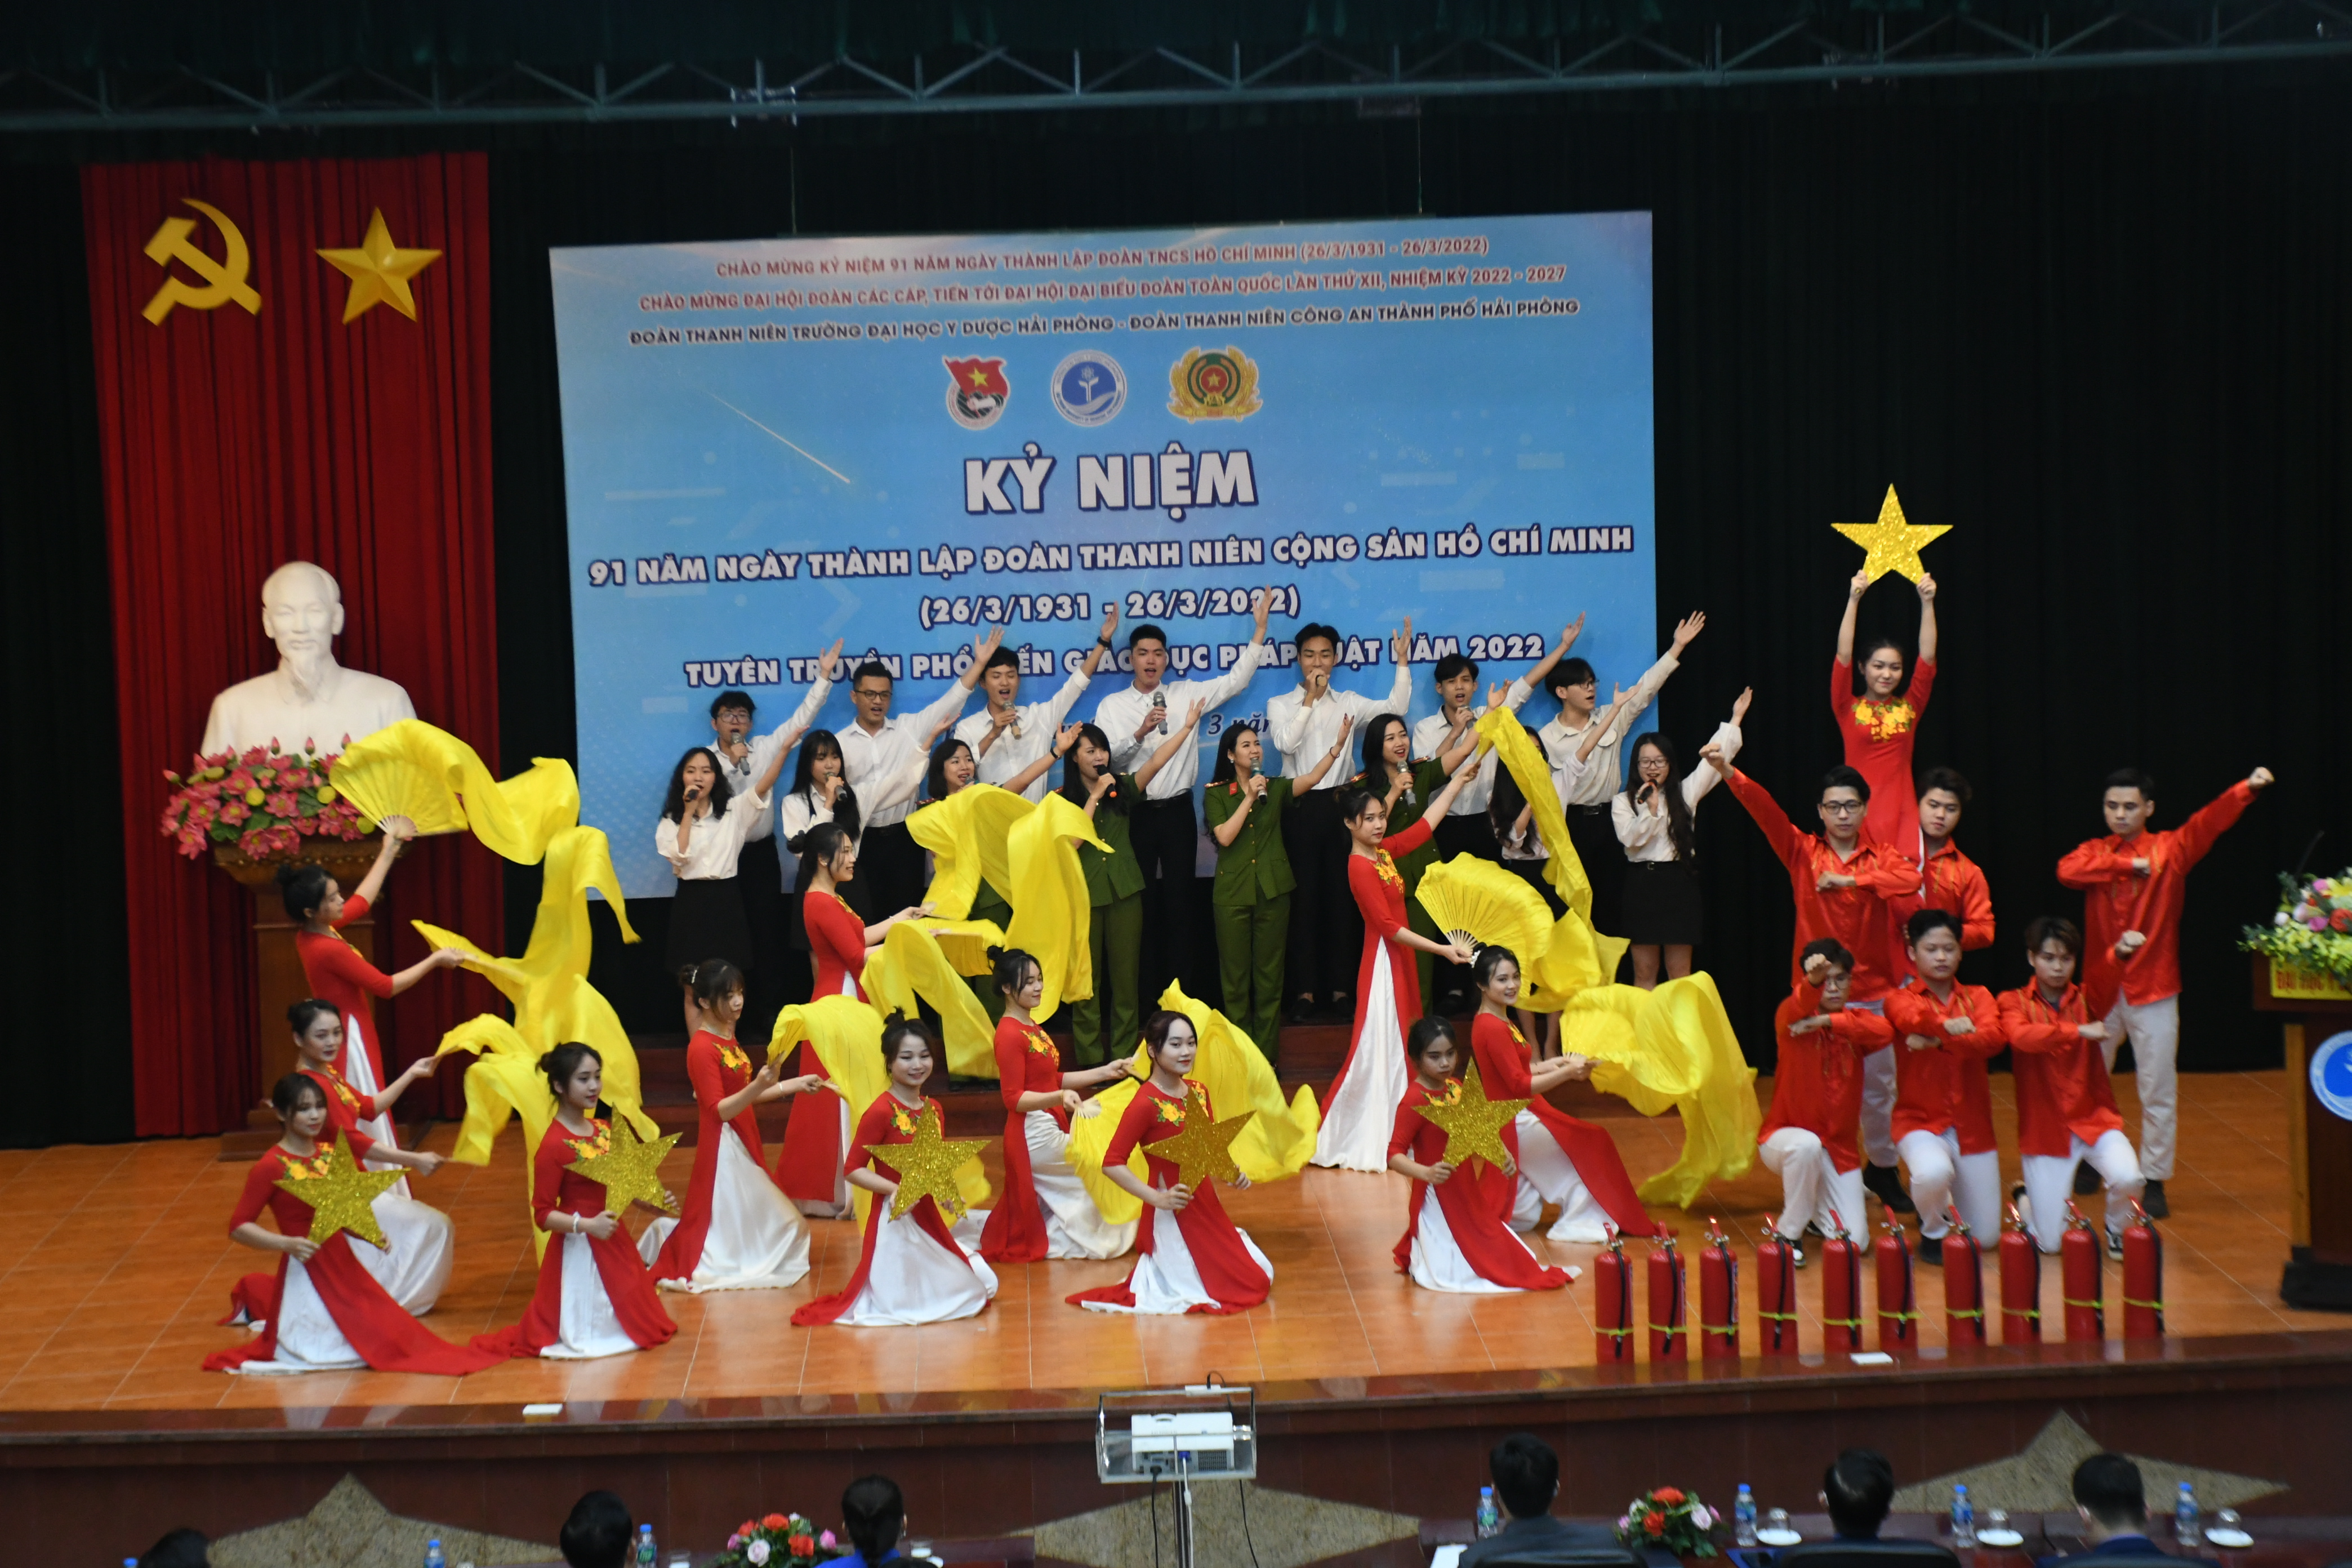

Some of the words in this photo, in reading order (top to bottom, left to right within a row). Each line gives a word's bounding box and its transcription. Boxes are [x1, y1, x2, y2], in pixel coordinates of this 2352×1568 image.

[890, 259, 907, 271] 91
[956, 252, 997, 270] NGÀY
[1003, 252, 1058, 269] THÀNH
[1062, 249, 1093, 271] LẬP
[1147, 249, 1190, 266] TNCS
[1222, 243, 1250, 262] CHÍ
[1254, 244, 1296, 261] MINH
[1301, 242, 1385, 262] (26/3/1931
[1402, 237, 1489, 256] 26/3/2022)
[639, 292, 685, 311] CHÀO
[743, 293, 771, 310] ĐẠI
[776, 288, 803, 310] HỘI
[808, 287, 853, 307] ĐOÀN
[857, 286, 889, 305] CÁC
[973, 282, 1000, 301] TỚI
[1004, 285, 1032, 303] ĐẠI
[1036, 280, 1064, 302] HỘI
[1069, 283, 1097, 302] ĐẠI
[1141, 278, 1185, 297] ĐOÀN
[1189, 275, 1233, 295] TOÀN
[1237, 273, 1282, 295] QUỐC
[1360, 273, 1386, 291] XII,
[1390, 267, 1442, 288] NHIỆM
[1472, 268, 1511, 284] 2022
[1526, 265, 1566, 283] 2027
[630, 325, 681, 345] ĐOÀN
[685, 328, 743, 344] THANH
[748, 323, 787, 341] NIÊN
[792, 321, 862, 341] TRƯỜNG
[867, 323, 897, 342] ĐẠI
[902, 322, 942, 341] HỌC
[946, 321, 957, 337] Y
[962, 317, 1013, 338] DƯỢC
[1017, 313, 1048, 335] HẢI
[1052, 313, 1113, 333] PHÒNG
[1129, 310, 1181, 331] ĐOÀN
[1184, 313, 1242, 329] THANH
[1246, 306, 1286, 327] NIÊN
[1290, 304, 1344, 326] CÔNG
[1348, 306, 1373, 323] AN
[1378, 301, 1436, 322] THÀNH
[1440, 297, 1477, 319] PHỐ
[1481, 297, 1512, 318] HẢI
[1516, 296, 1580, 317] PHÒNG
[965, 442, 1055, 514] KỶ
[1077, 441, 1259, 522] NIỆM
[589, 561, 625, 586] 91
[636, 554, 709, 584] NĂM
[715, 549, 801, 581] NGÀY
[807, 546, 910, 578] THÀNH
[919, 544, 975, 580] LẬP
[982, 542, 1071, 572] ĐOÀN
[1079, 541, 1183, 569] THANH
[1190, 534, 1264, 565] NIÊN
[1271, 532, 1358, 568] CỘNG
[1366, 527, 1427, 559] SẢN
[1435, 522, 1482, 557] HỒ
[1489, 523, 1542, 555] CHÍ
[1548, 525, 1633, 554] MINH
[919, 595, 1092, 630] (26/3/1931
[1125, 584, 1300, 619] 26/3/2022)
[685, 656, 781, 687] TUYÊN
[1165, 645, 1210, 676] ỤC
[1218, 638, 1298, 669] PÁP
[1467, 633, 1545, 661] 2022
[1207, 713, 1223, 736] 3
